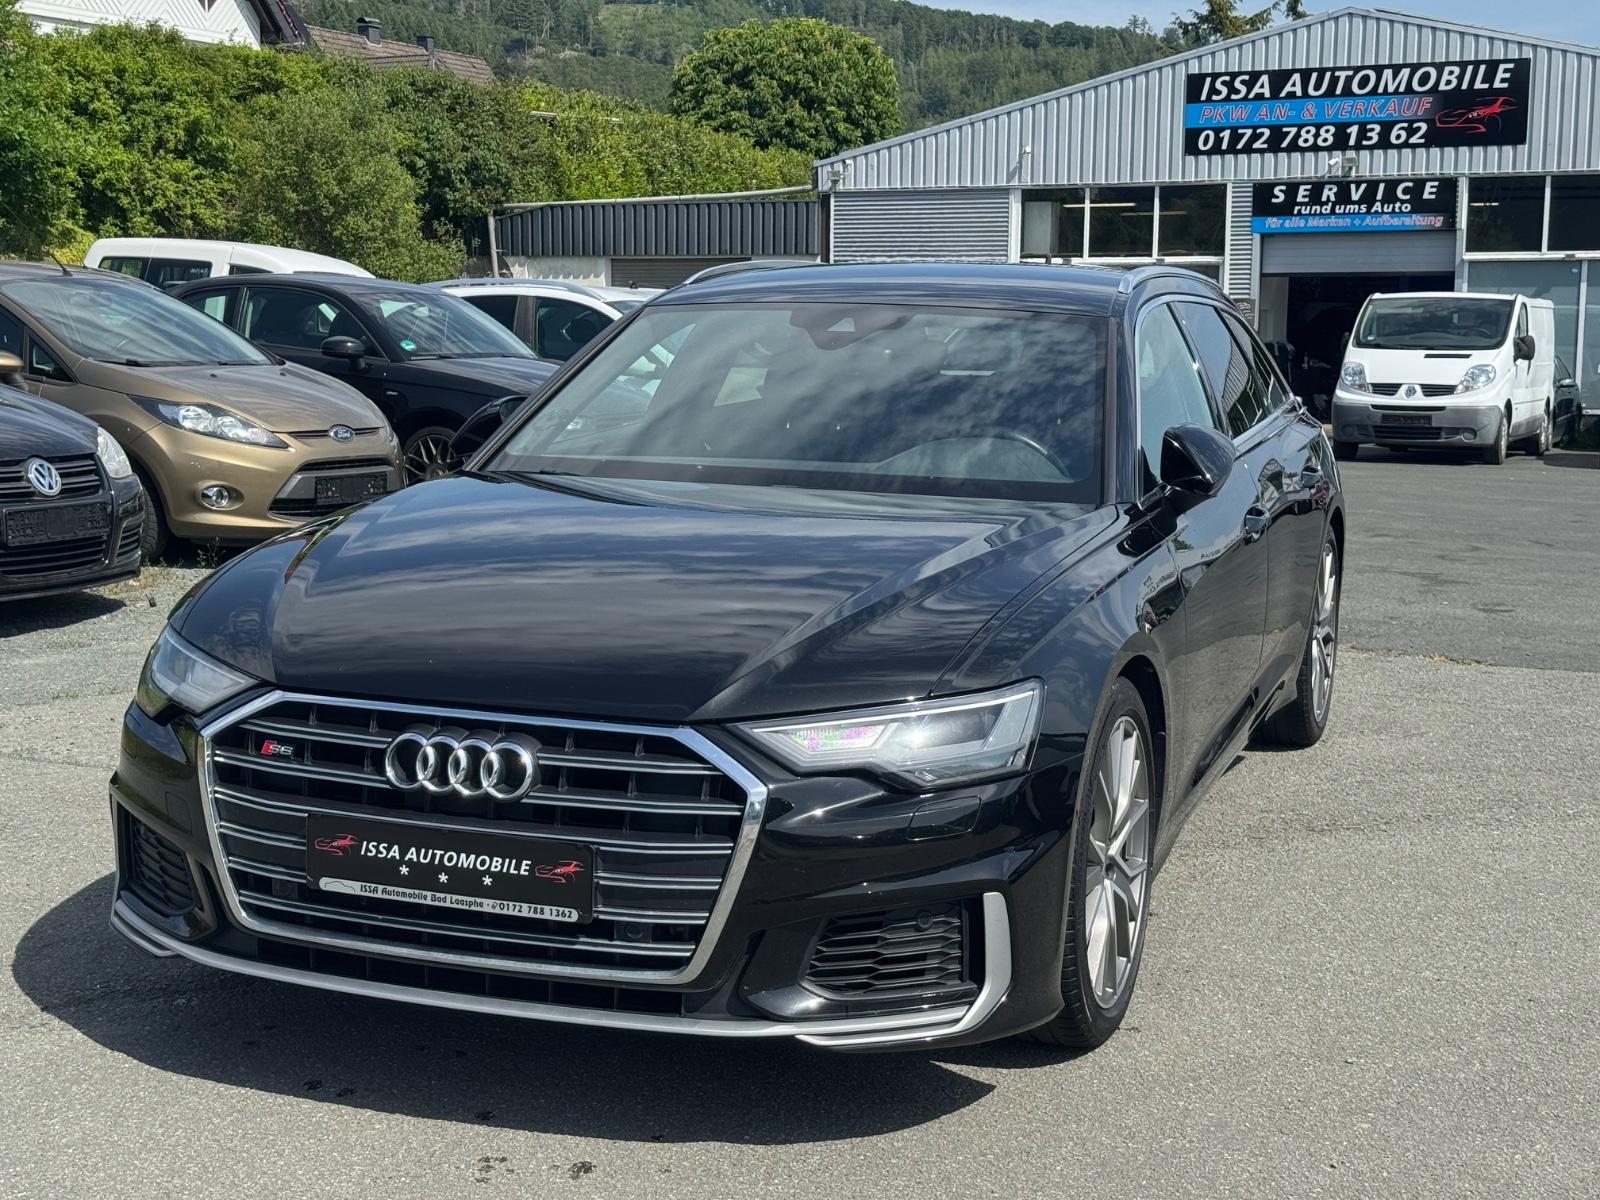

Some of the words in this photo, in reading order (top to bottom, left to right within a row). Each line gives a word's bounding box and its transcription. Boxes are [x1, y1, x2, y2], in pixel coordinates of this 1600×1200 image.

[1200, 73, 1271, 101] ISSA
[1279, 63, 1515, 98] AUTOMOBILE
[1199, 105, 1252, 124] PKW
[1254, 103, 1296, 122] AN-
[1302, 101, 1318, 120] &
[1324, 96, 1433, 119] VERKAUF
[1197, 127, 1271, 151] 0172
[1280, 124, 1336, 149] 788
[1345, 123, 1381, 147] 13
[1389, 121, 1428, 145] 62
[1271, 180, 1440, 204] SERVICE
[1265, 216, 1284, 229] für
[1283, 216, 1306, 228] alle
[1293, 201, 1333, 215] rund
[1334, 204, 1368, 214] ums
[1370, 201, 1412, 213] Auto
[360, 840, 401, 860] ISSA
[404, 846, 532, 876] AUTOMOBILE
[360, 883, 379, 895] ISSA
[381, 887, 428, 901] Automobile
[430, 893, 448, 904] Bad
[449, 895, 485, 910] Laasphe
[499, 902, 523, 913] 0172
[527, 905, 545, 916] 788
[549, 908, 573, 919] 1362
